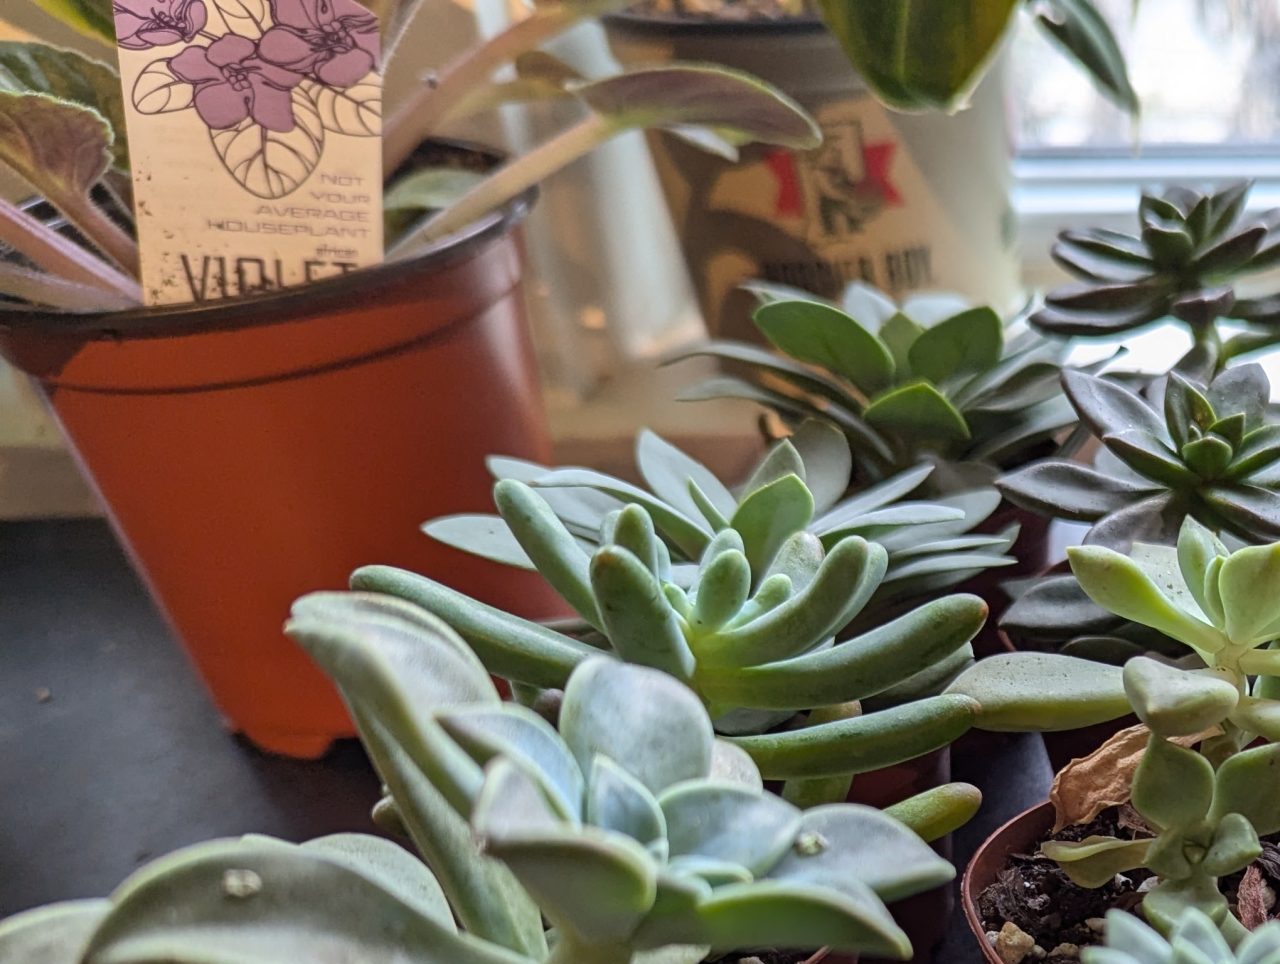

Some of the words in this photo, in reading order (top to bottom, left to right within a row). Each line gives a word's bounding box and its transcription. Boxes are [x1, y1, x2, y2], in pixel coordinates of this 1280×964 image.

[320, 173, 364, 187] NOT
[309, 191, 370, 204] YOUR
[256, 205, 370, 222] AVERAGE
[206, 219, 371, 239] HOUSEPLANT
[181, 253, 359, 302] VIOL
